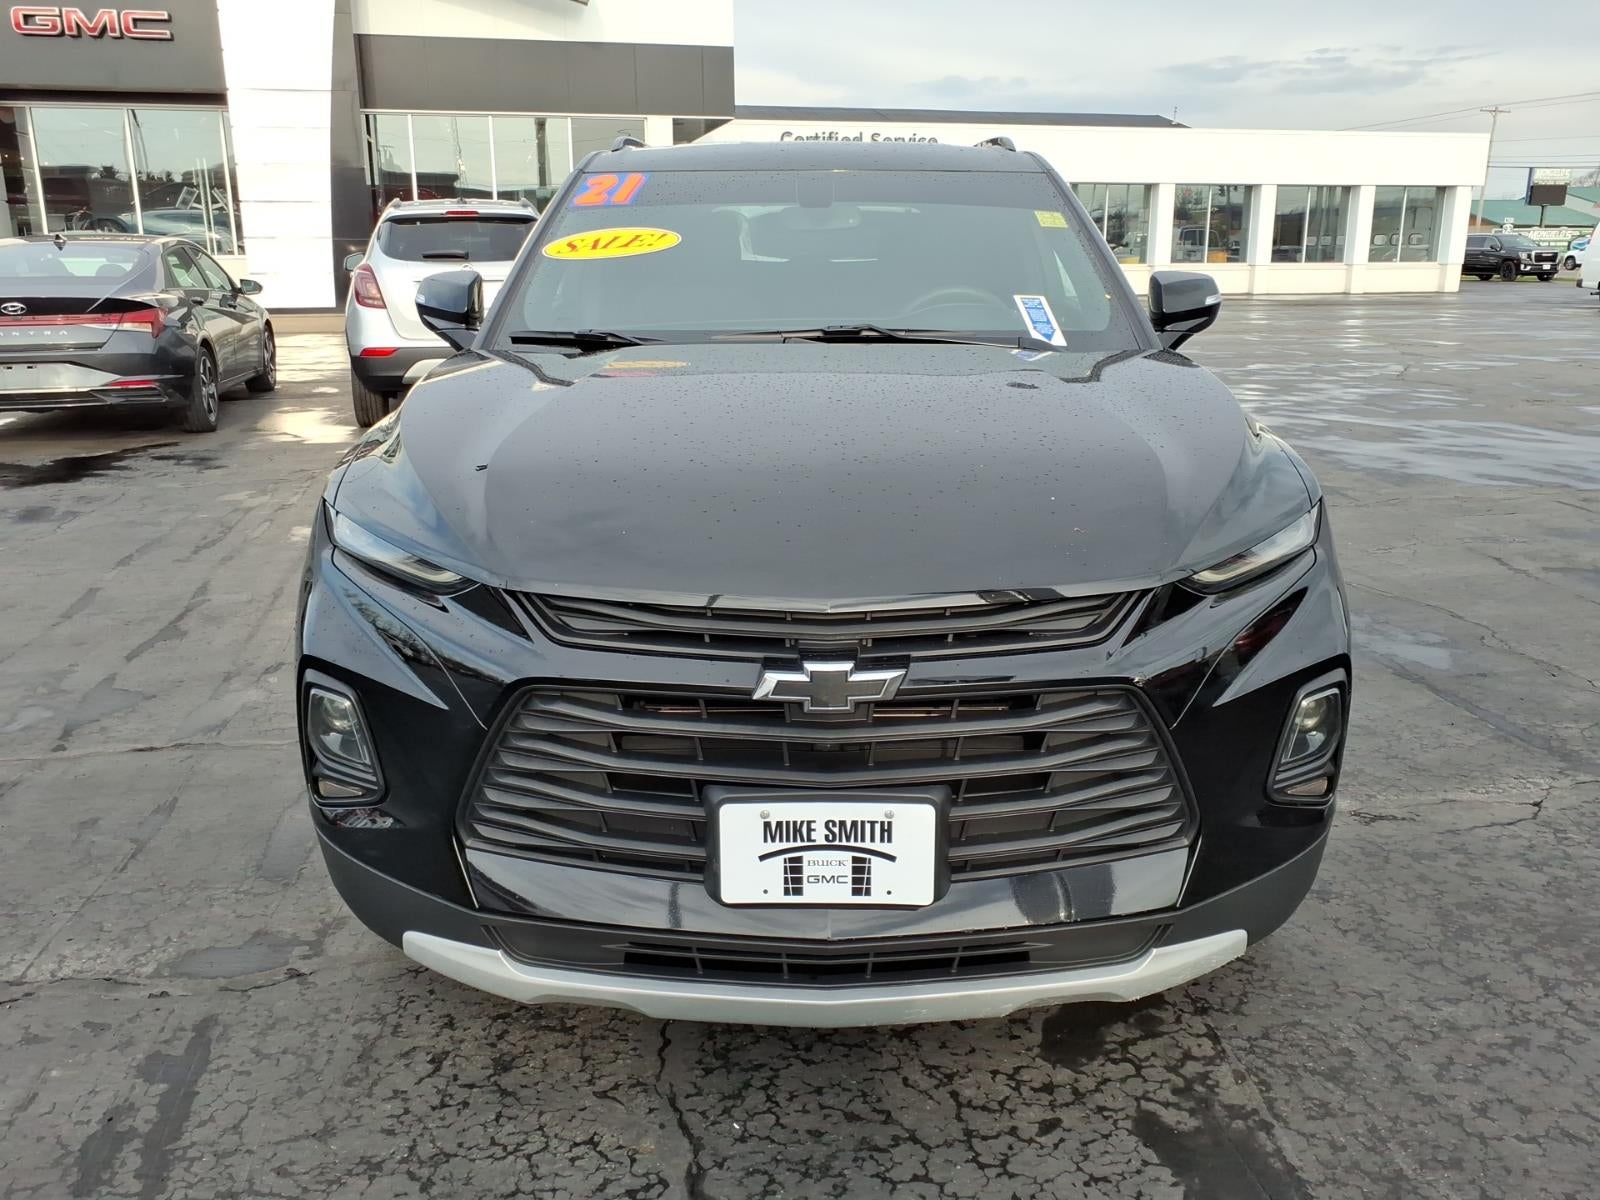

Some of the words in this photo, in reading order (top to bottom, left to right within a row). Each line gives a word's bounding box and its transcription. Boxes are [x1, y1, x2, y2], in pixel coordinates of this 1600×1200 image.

[11, 6, 172, 40] GMC
[574, 172, 646, 206] 21
[556, 233, 668, 254] SALE!
[763, 820, 816, 843] MIKE
[824, 820, 893, 843] SMITH
[807, 875, 848, 884] GMC
